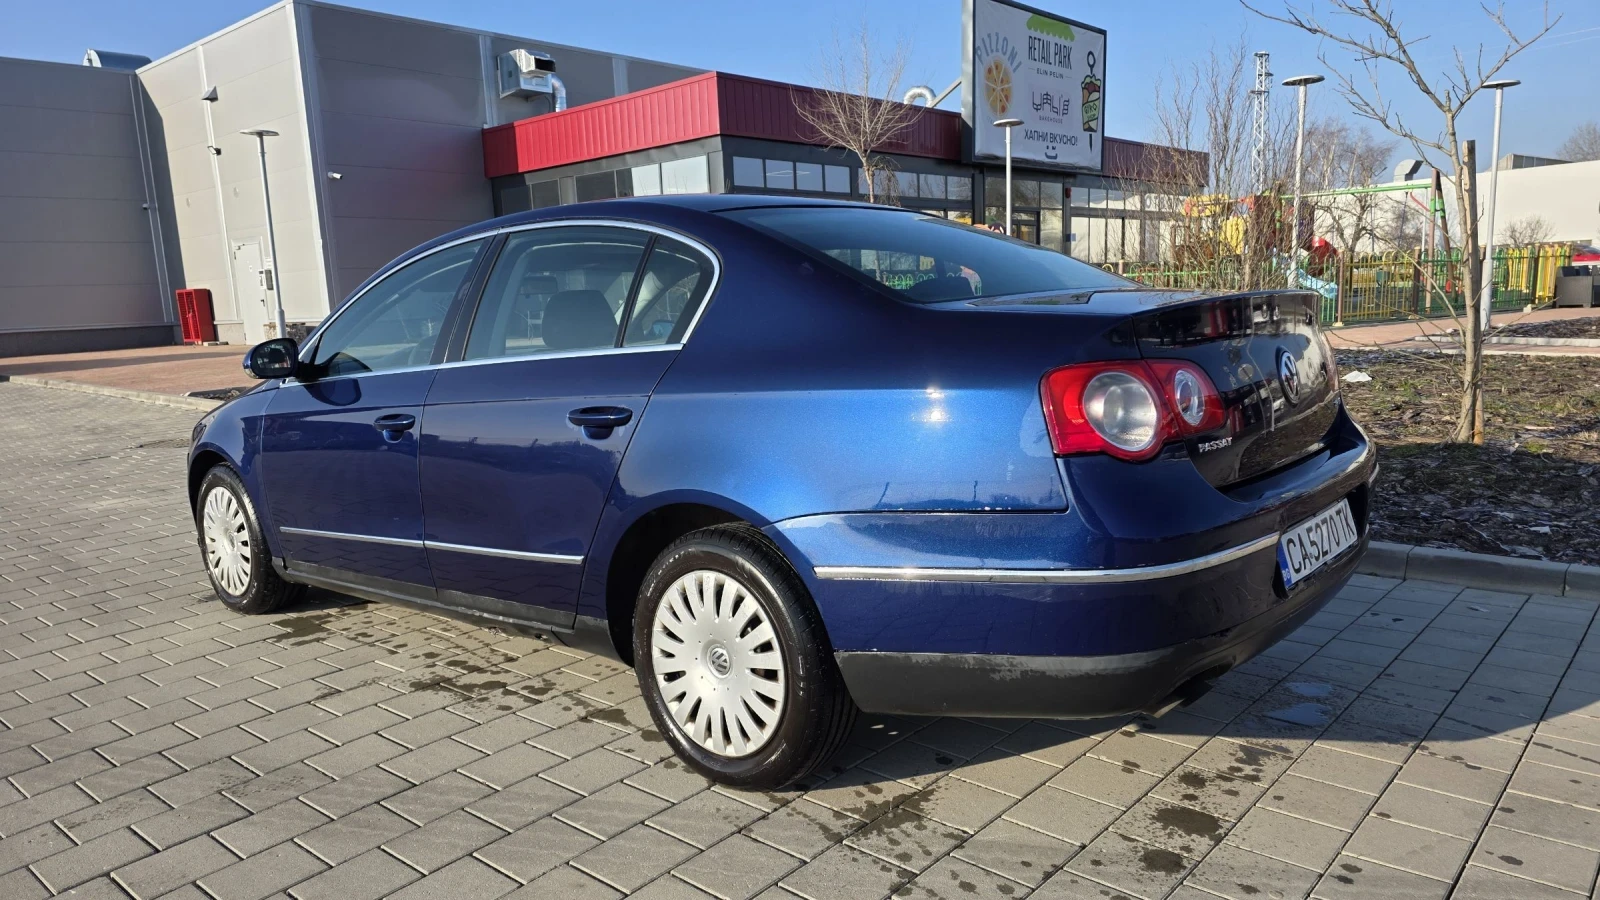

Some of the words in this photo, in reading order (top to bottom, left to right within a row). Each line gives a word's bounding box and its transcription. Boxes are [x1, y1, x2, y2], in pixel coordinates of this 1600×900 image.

[976, 32, 1022, 73] PIZZONI
[1028, 35, 1052, 65] RETAIL
[1054, 42, 1072, 70] PARK
[1036, 67, 1048, 77] ELIN
[1049, 71, 1064, 80] PELIN
[1024, 128, 1048, 143] ХАПНИ
[1049, 132, 1078, 146] ВКУСНО!
[1198, 437, 1233, 453] PASSAT
